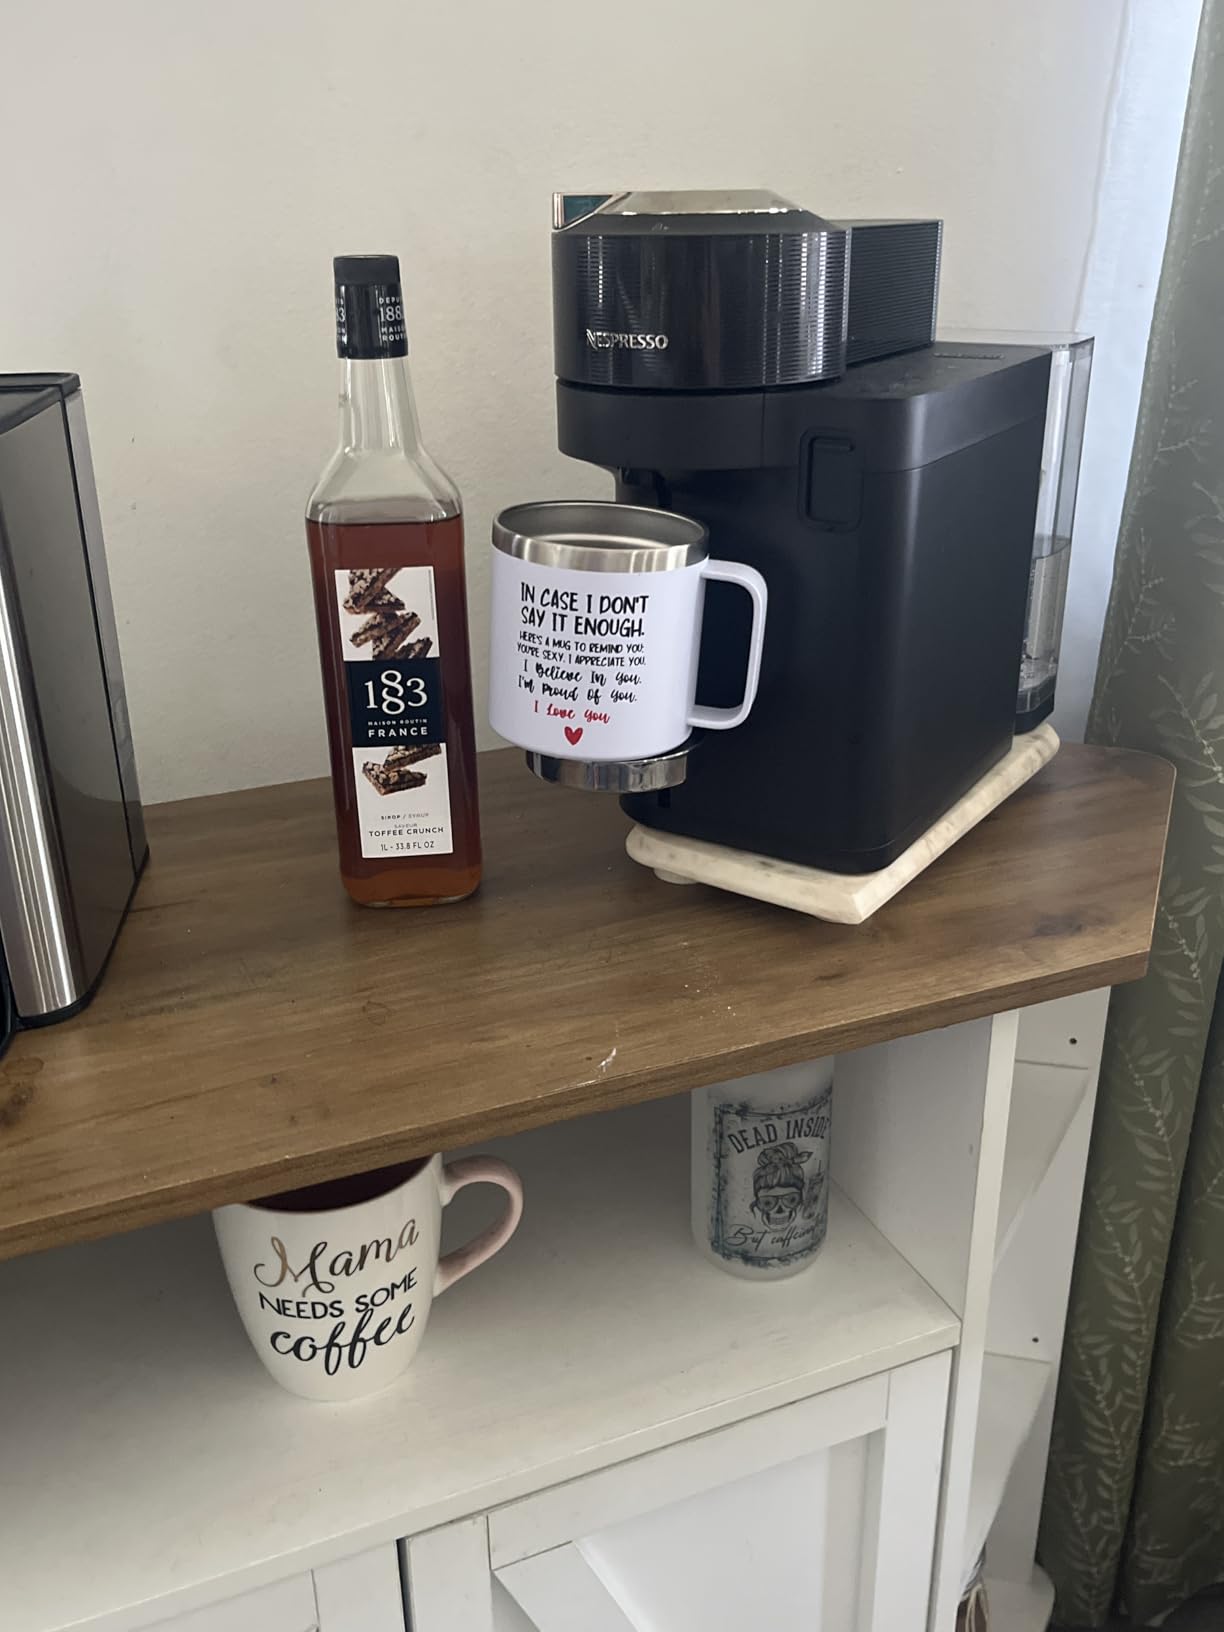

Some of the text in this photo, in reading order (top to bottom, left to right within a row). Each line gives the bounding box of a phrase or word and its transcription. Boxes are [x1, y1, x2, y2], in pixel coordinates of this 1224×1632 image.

[380, 305, 403, 322] 188
[586, 331, 669, 350] NESPRESSO
[521, 582, 649, 615] IN CASE I DON'T
[521, 606, 645, 638] SAY IT ENOUGH.
[517, 642, 540, 658] YOU'RE
[542, 650, 566, 663] SEXY.
[574, 655, 625, 667] APPRECIATE
[519, 630, 543, 645] HERE'S
[545, 636, 550, 646] A
[552, 638, 571, 650] MUG
[574, 641, 587, 652] TO
[589, 643, 623, 654] REMIND
[523, 659, 528, 672] I
[535, 662, 582, 683] Believe
[590, 671, 607, 687] In
[518, 675, 535, 693] I'm
[542, 682, 578, 701] Proud
[534, 700, 539, 713] I
[546, 703, 575, 719] Love
[368, 727, 428, 738] FRANCE
[368, 827, 444, 837] TOFFEE CRUNCH
[423, 840, 435, 849] OZ
[728, 1123, 778, 1153] DEAD
[253, 1218, 419, 1298] Mama
[258, 1266, 418, 1320] NEEDS SOME
[270, 1303, 415, 1376] coffee
